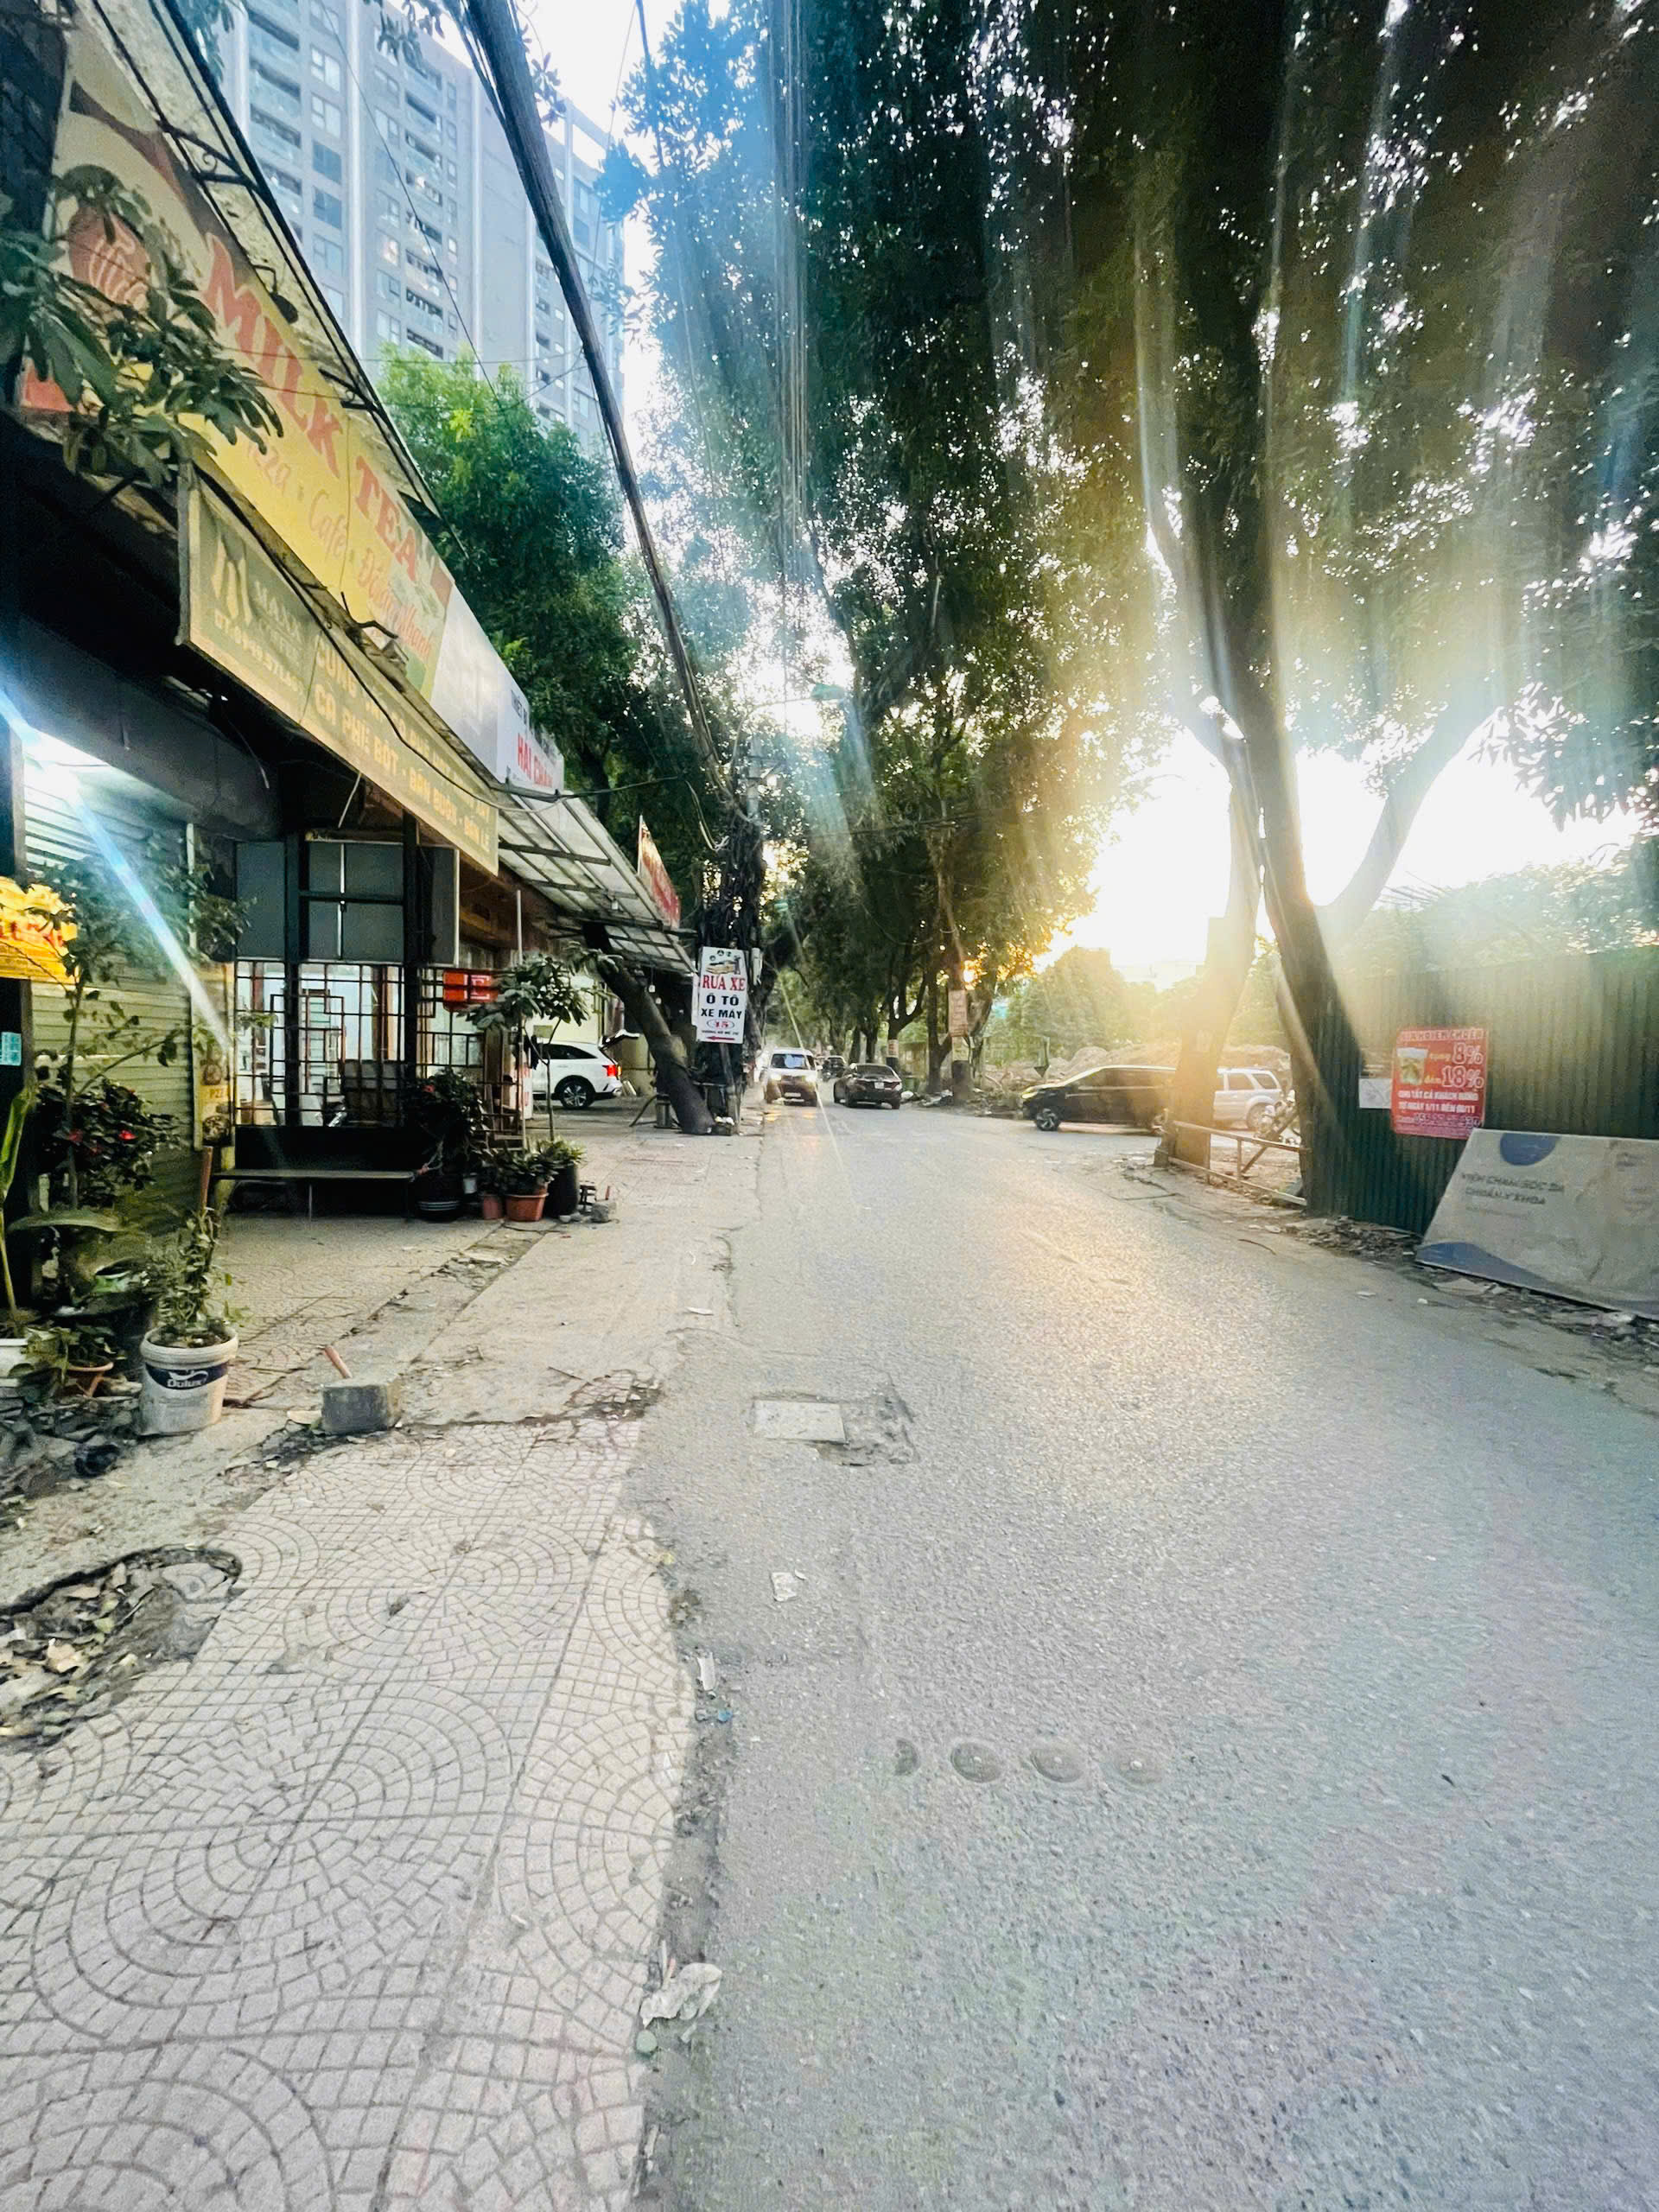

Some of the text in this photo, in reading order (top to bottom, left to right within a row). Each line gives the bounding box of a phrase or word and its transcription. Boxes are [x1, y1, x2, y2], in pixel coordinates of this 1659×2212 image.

[201, 232, 417, 582] MILK TEA
[730, 976, 746, 991] XE
[706, 992, 739, 1006] Ô TÔ
[701, 1008, 715, 1017] XE
[1452, 1042, 1484, 1065] 8%
[1441, 1065, 1484, 1089] 18%
